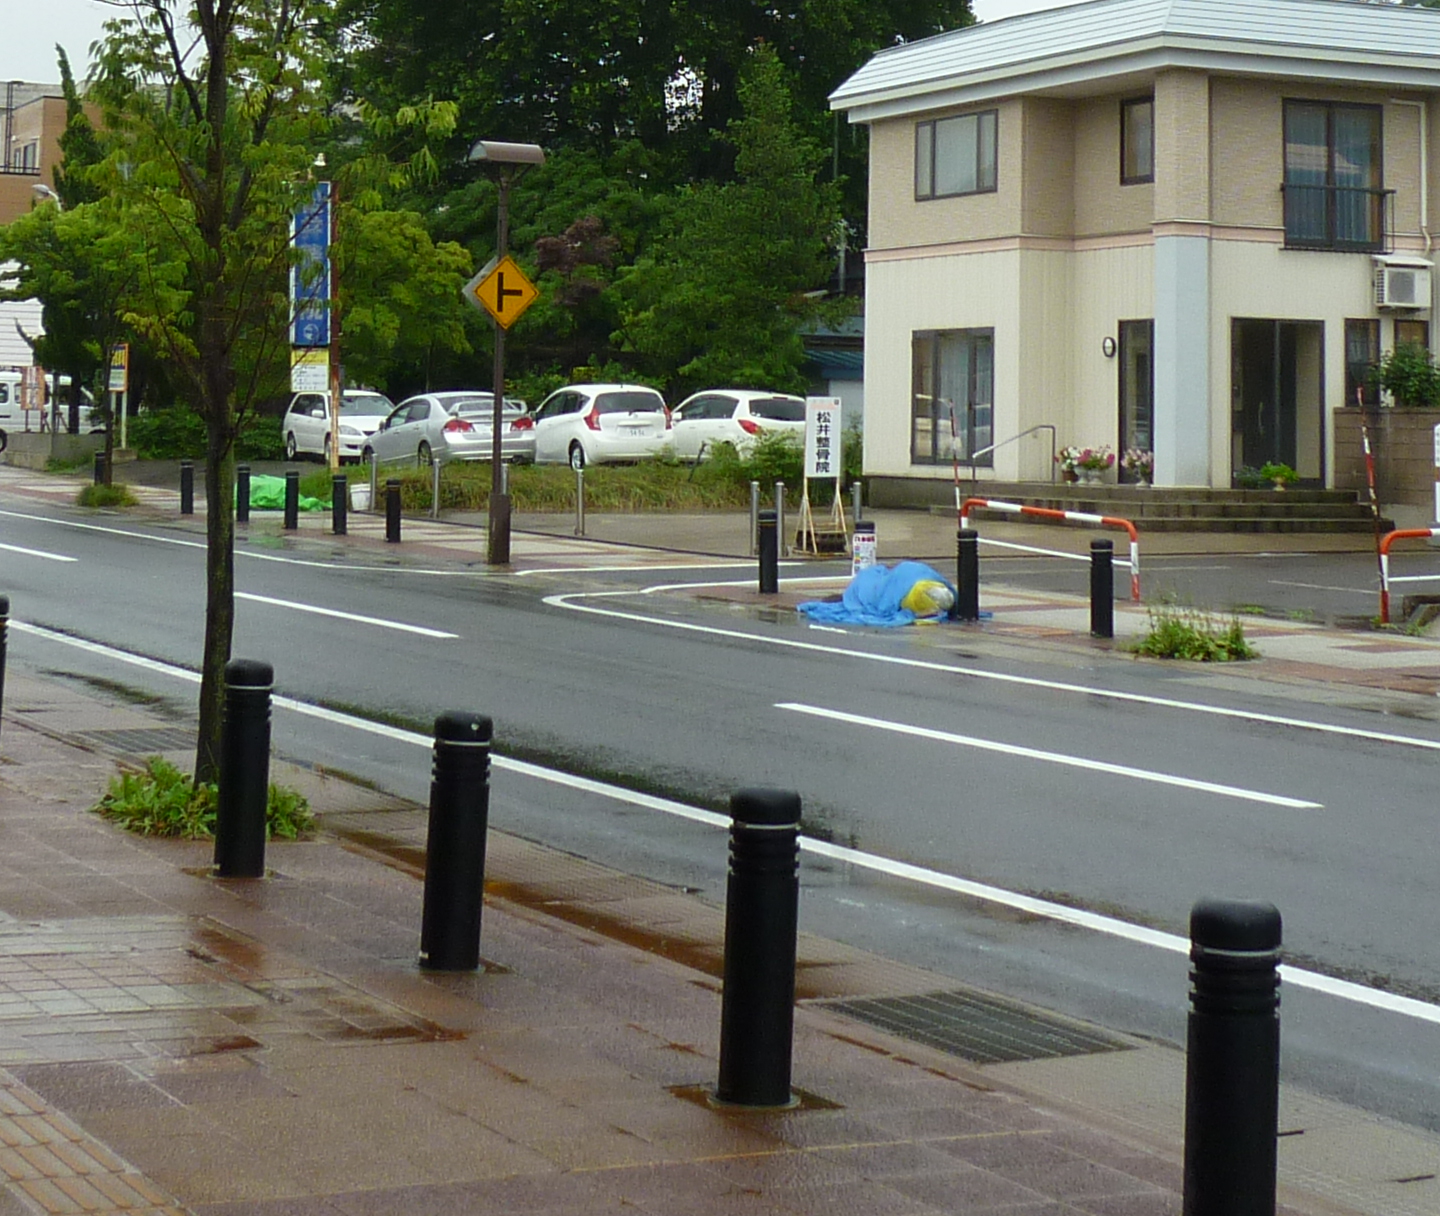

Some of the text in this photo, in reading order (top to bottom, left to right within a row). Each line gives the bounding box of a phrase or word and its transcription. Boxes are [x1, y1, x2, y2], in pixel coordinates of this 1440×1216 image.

[816, 412, 831, 473] 松井整骨院
